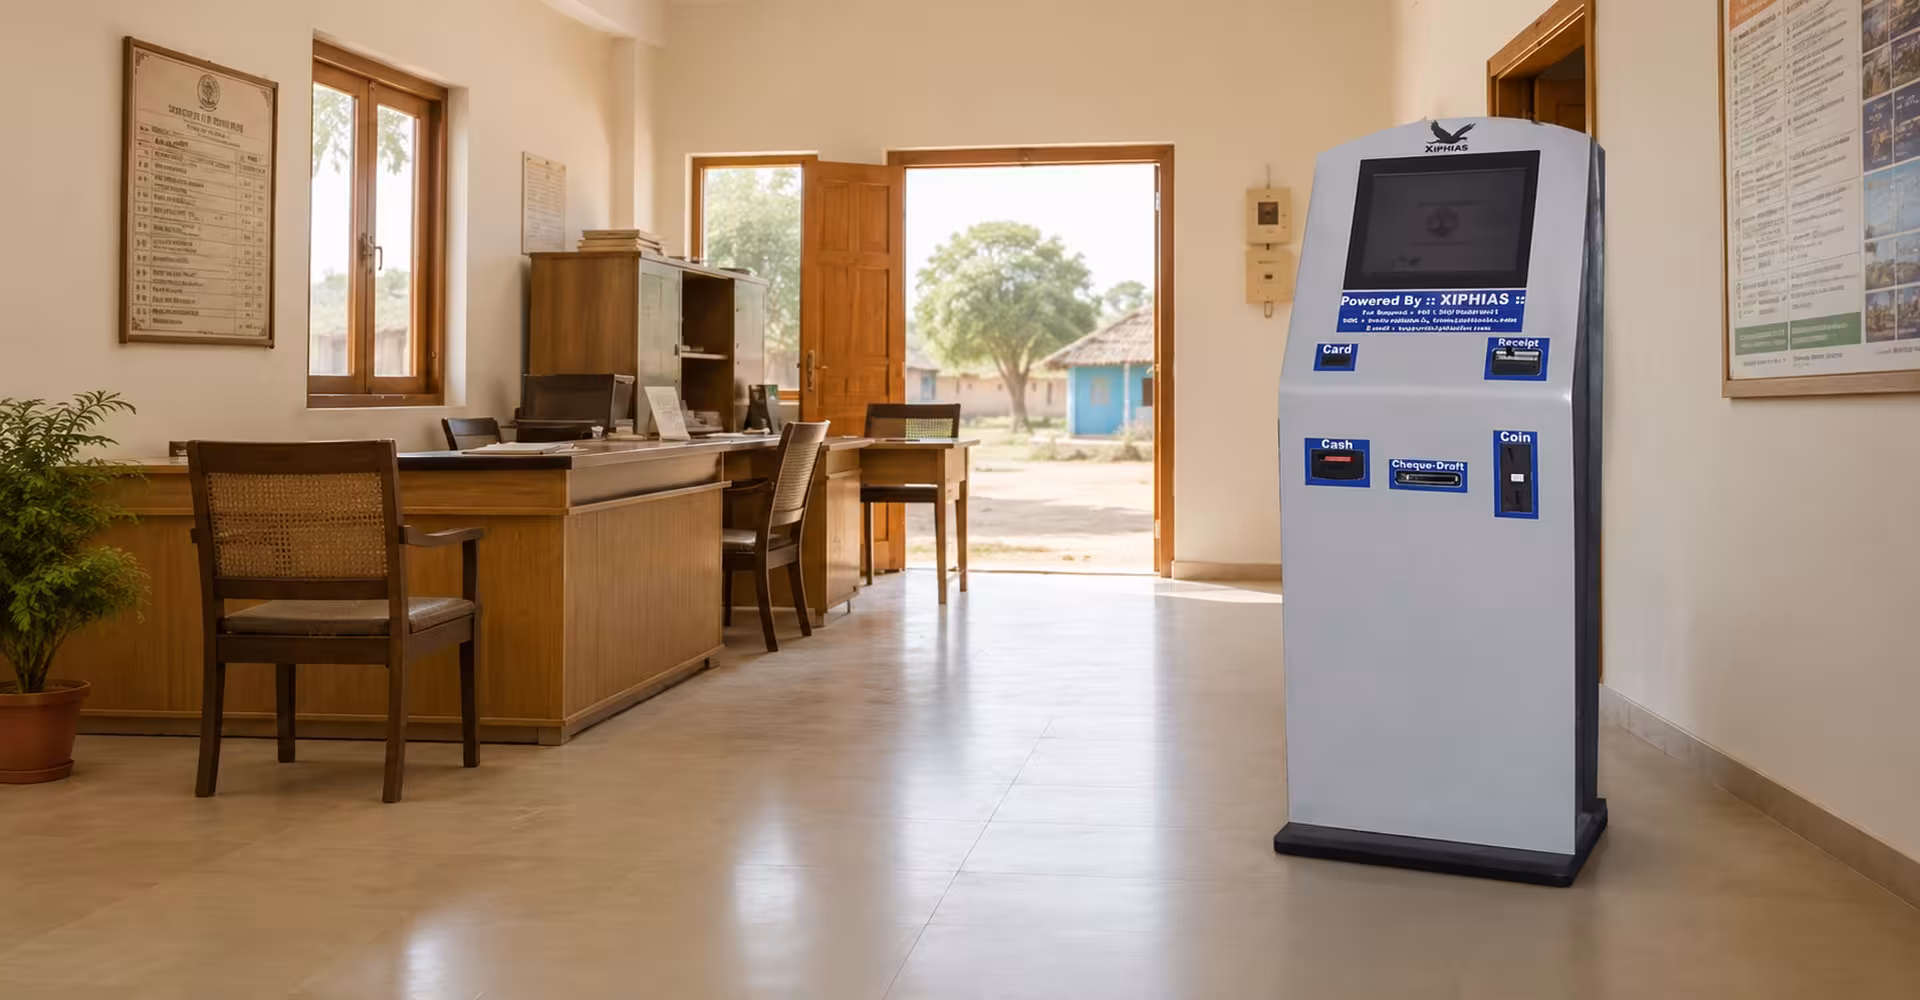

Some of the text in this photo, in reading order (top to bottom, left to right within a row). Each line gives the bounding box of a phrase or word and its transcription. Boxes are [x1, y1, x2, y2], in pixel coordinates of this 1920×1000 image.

[1341, 296, 1399, 306] Powered
[1404, 296, 1422, 309] By
[1440, 293, 1509, 306] XIPHIAS
[1498, 338, 1539, 348] Receipt
[1323, 344, 1352, 354] Card
[1500, 431, 1531, 442] Coin
[1321, 439, 1353, 449] Cash
